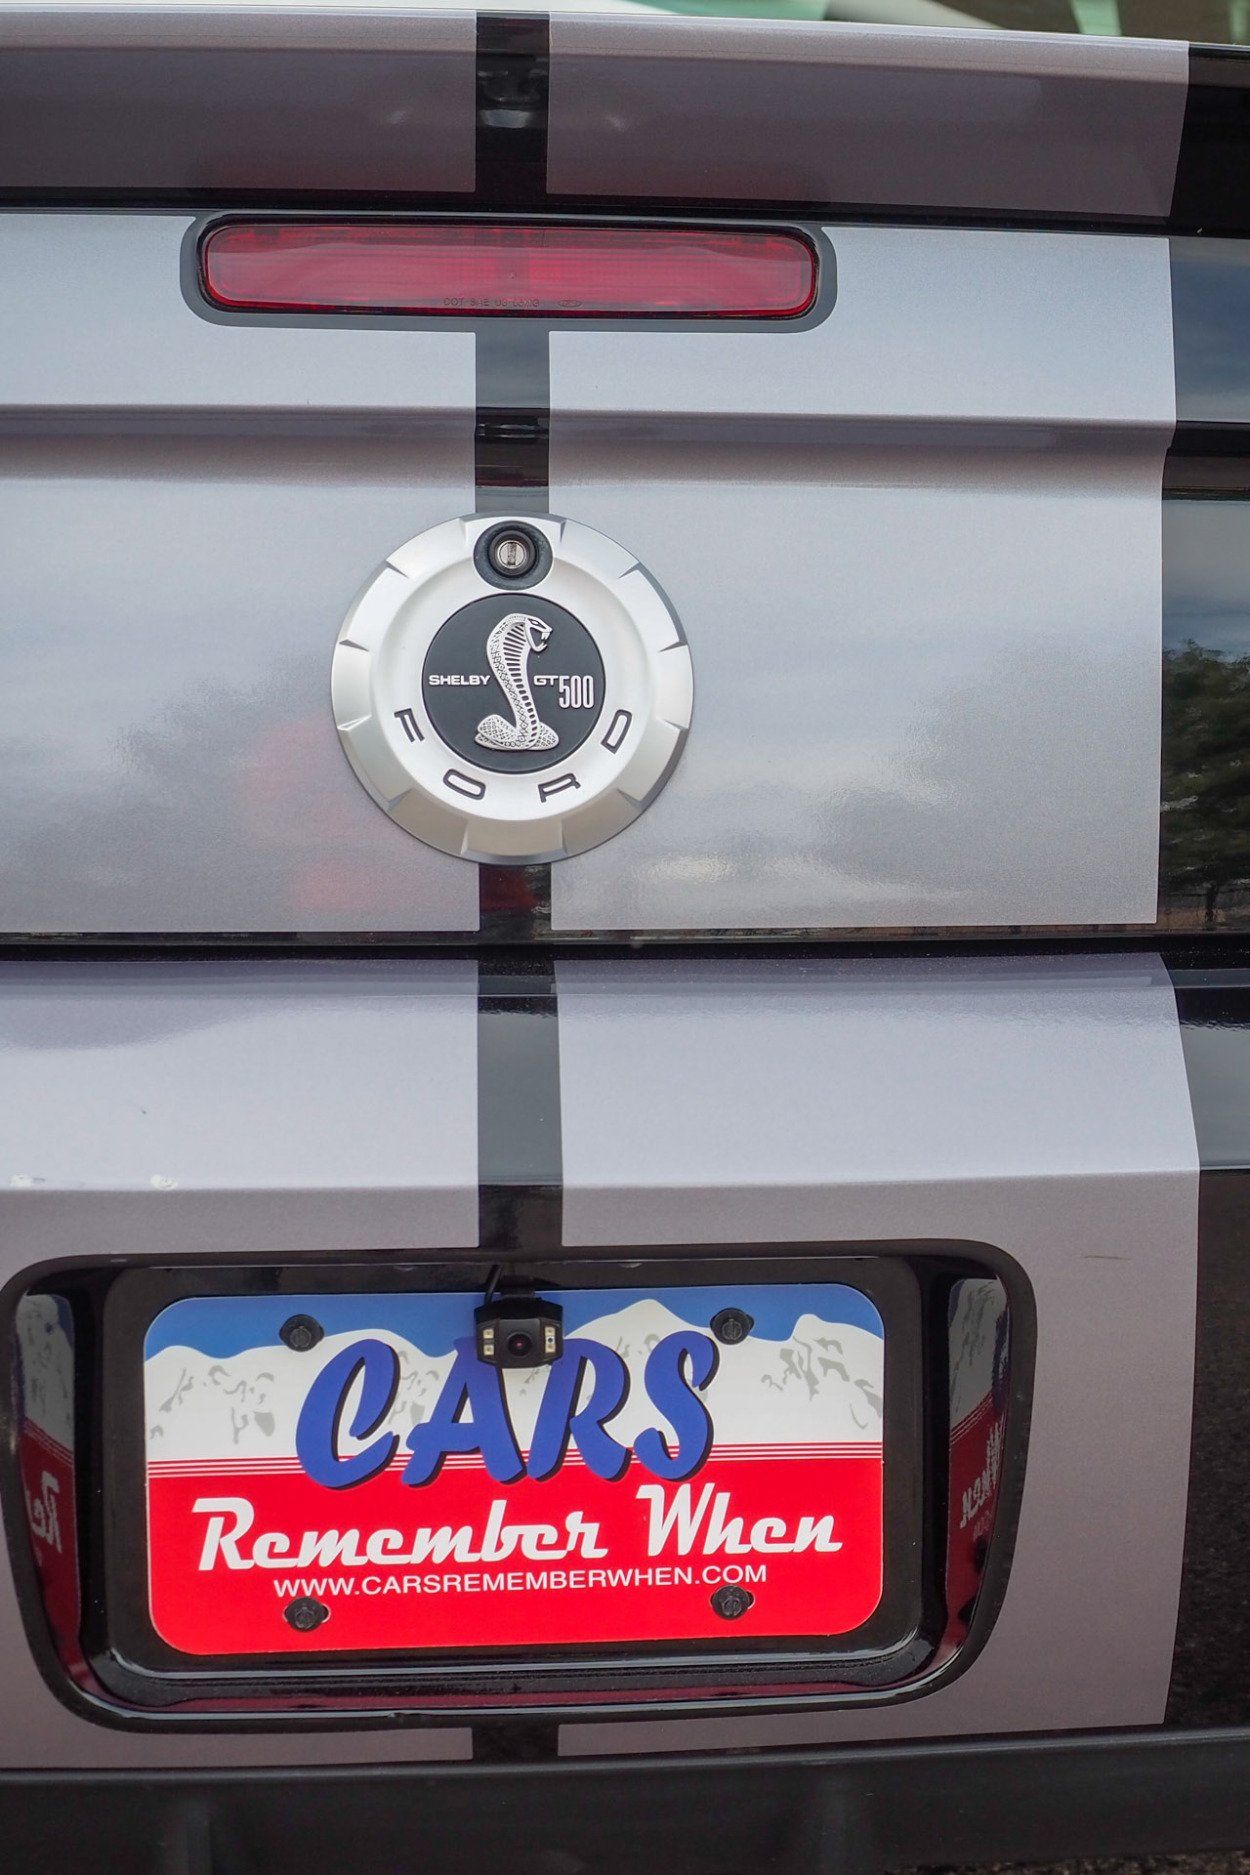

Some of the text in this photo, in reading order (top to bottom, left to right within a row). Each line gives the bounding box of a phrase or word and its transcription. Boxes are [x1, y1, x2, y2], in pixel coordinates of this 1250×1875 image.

[428, 675, 491, 686] SHELBY
[394, 708, 633, 803] FORD
[295, 1330, 720, 1491] CARS
[192, 1483, 843, 1571] Remember When
[274, 1565, 767, 1597] WWW.CARSREMEMBERWHEN.COM
